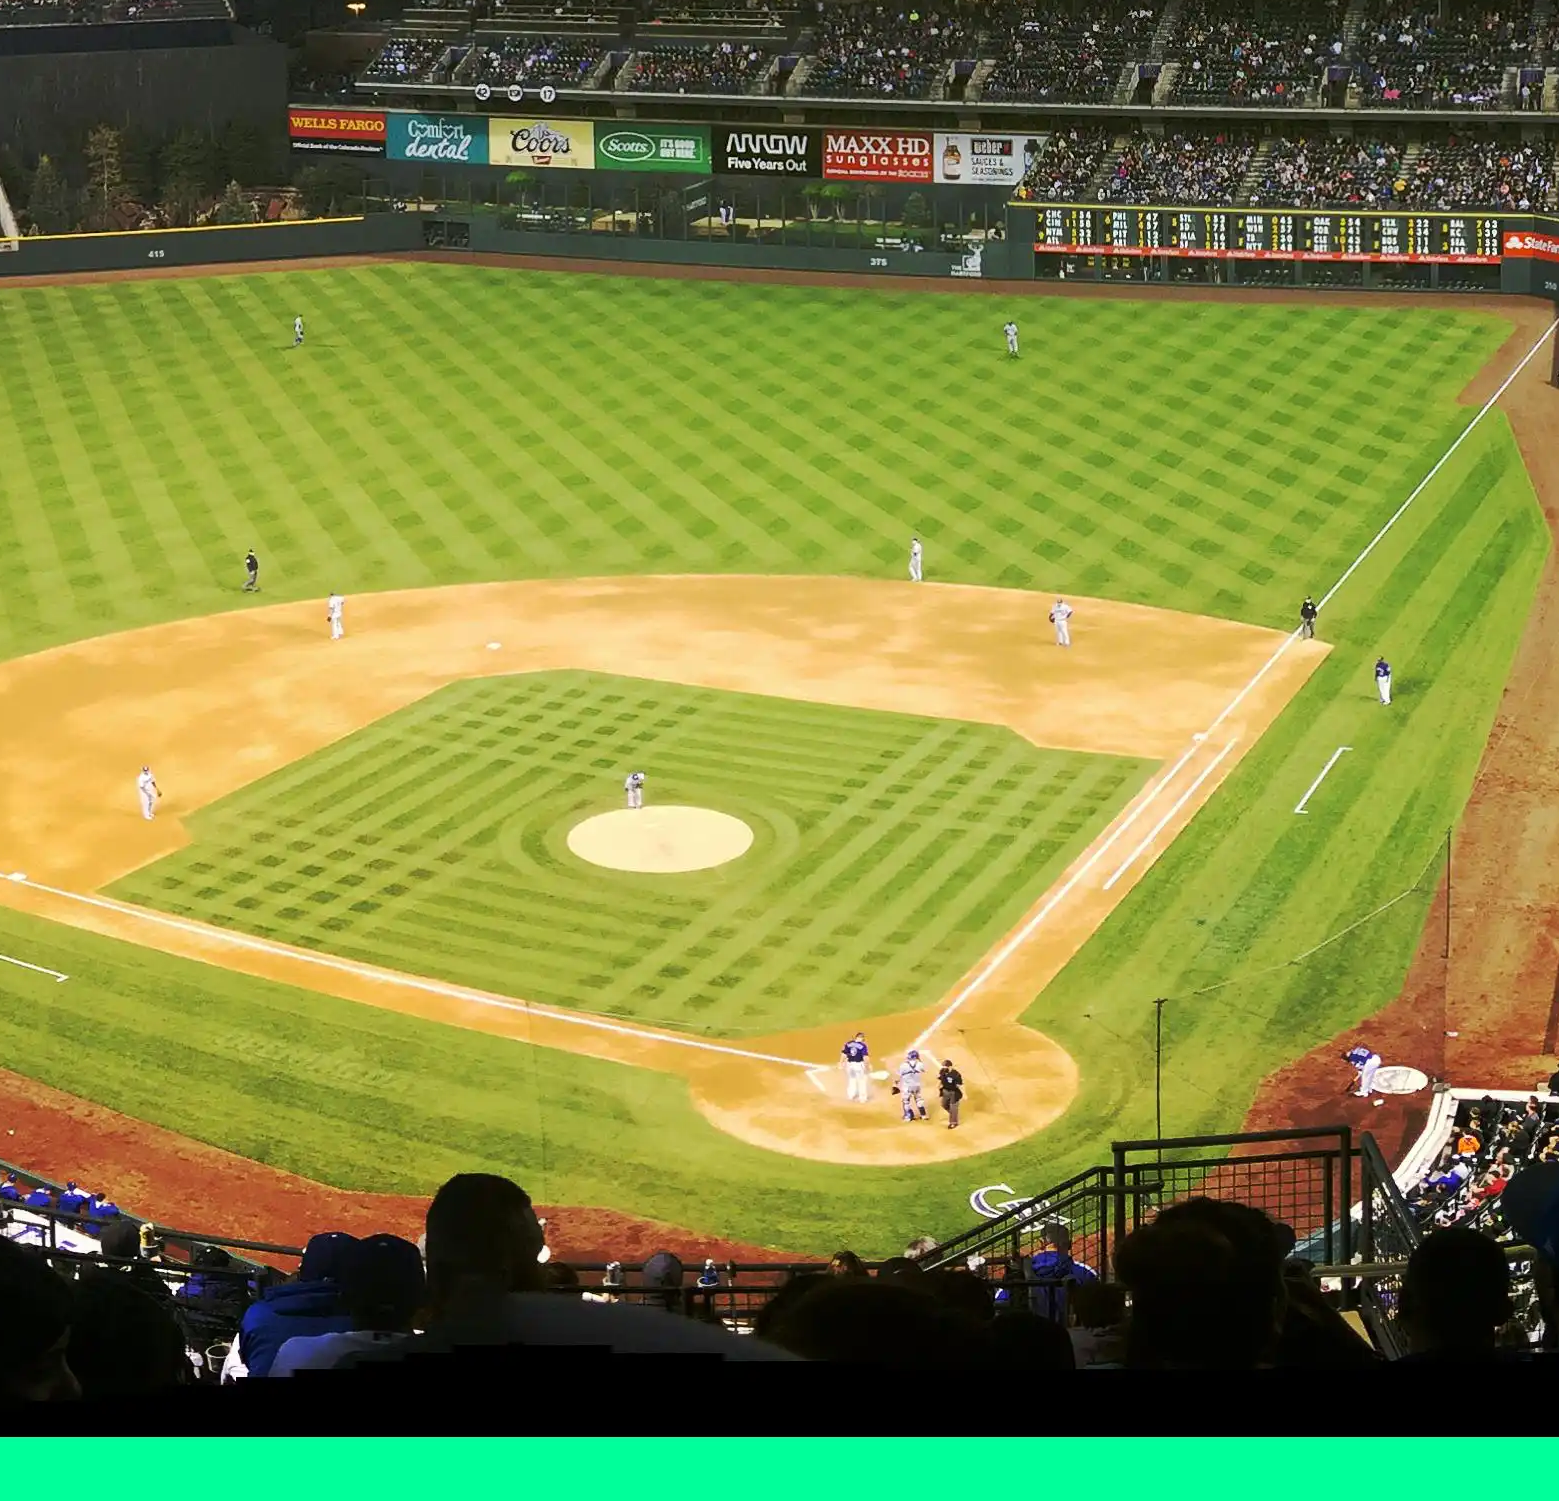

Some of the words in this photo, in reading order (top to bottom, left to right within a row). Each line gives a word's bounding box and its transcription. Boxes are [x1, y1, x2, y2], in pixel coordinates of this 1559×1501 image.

[543, 90, 553, 99] 17
[291, 117, 337, 130] WELLS
[339, 119, 384, 132] FARGO
[510, 128, 572, 153] Coors
[726, 133, 808, 155] ARROW
[826, 134, 896, 155] MAXX
[405, 135, 472, 160] dental
[608, 139, 649, 153] Scotts
[973, 138, 1003, 154] weber
[728, 157, 751, 170] Five
[752, 158, 784, 171] Years
[786, 159, 807, 172] Out
[826, 154, 929, 167] sunglasses
[971, 157, 997, 166] SAUCES
[971, 168, 1013, 176] SEASONINGS
[1046, 210, 1062, 218] CHC
[1113, 212, 1126, 220] PHI
[1180, 214, 1191, 222] STL
[1046, 219, 1061, 227] CIN
[1246, 216, 1263, 224] MIN
[1314, 217, 1330, 226] OAK
[1382, 218, 1396, 226] TEX
[1450, 220, 1464, 228] BAL
[1485, 220, 1497, 228] 63
[1113, 221, 1127, 229] MIL
[1180, 223, 1189, 231] SD
[1046, 228, 1063, 236] NYM
[1113, 230, 1127, 238] PIT
[1180, 232, 1196, 240] MIA
[1450, 229, 1461, 237] KC
[1485, 229, 1497, 237] 39
[1382, 237, 1397, 245] BOS
[1450, 238, 1465, 246] SEA
[1450, 247, 1465, 255] LAA
[870, 258, 888, 266] 375
